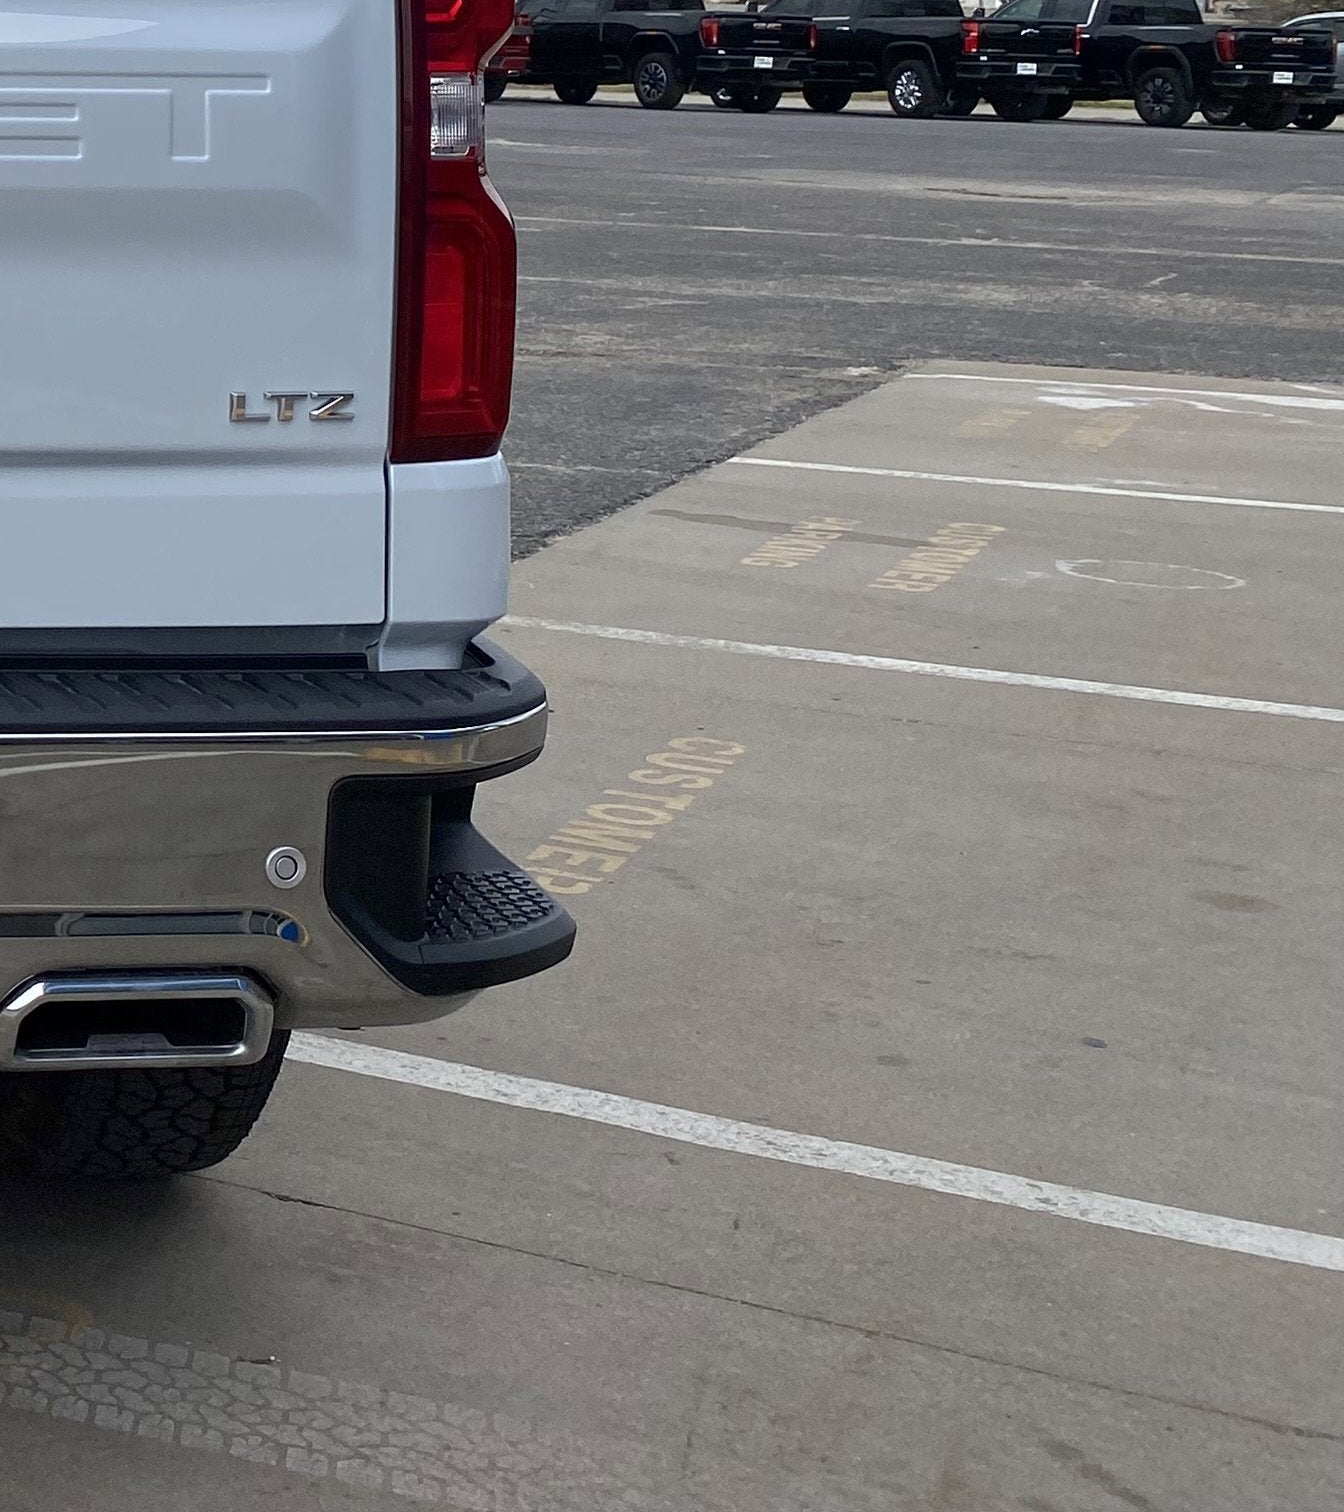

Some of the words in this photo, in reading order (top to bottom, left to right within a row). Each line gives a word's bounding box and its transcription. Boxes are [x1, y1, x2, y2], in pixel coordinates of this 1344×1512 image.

[230, 390, 355, 422] LTZ
[867, 522, 1006, 593] CUSTOMER
[524, 736, 747, 895] CUSTOMER
